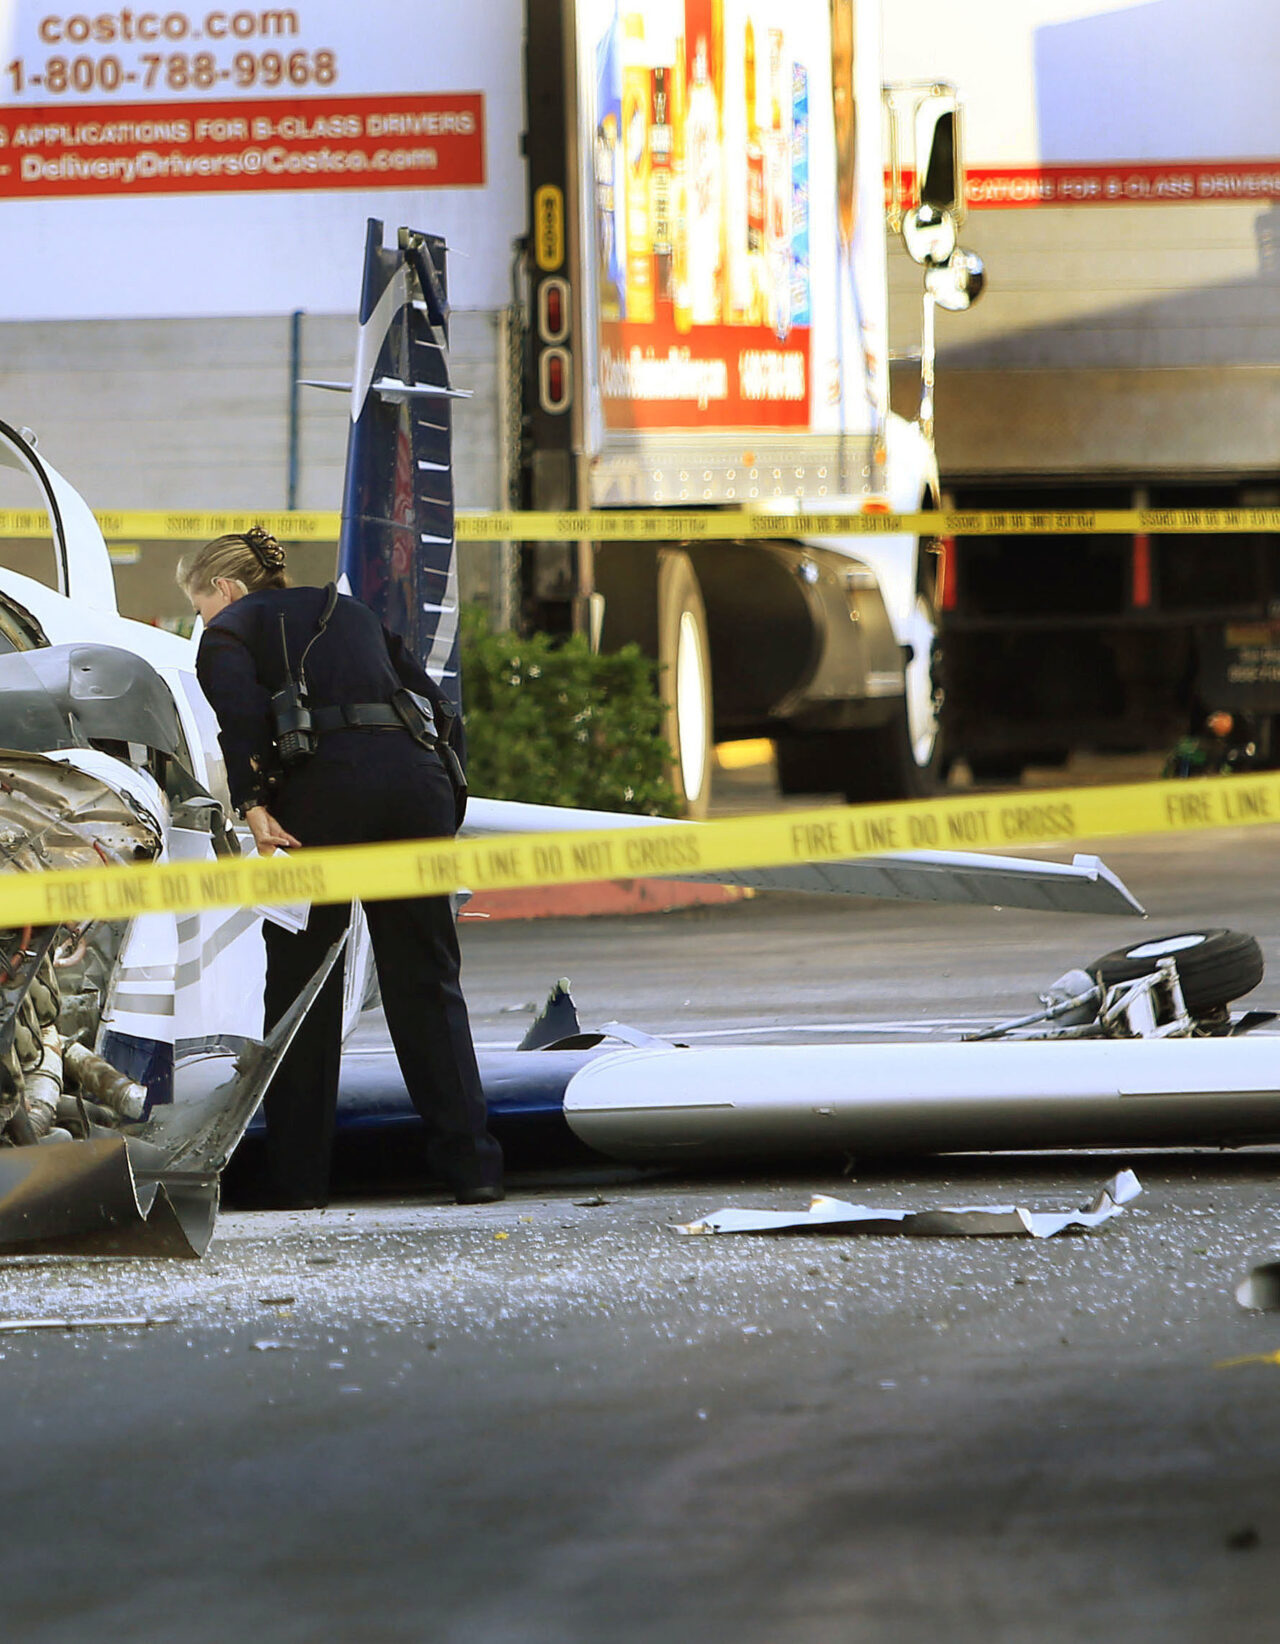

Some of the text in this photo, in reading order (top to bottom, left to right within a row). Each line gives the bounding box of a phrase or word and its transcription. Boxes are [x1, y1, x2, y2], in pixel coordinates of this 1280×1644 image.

[38, 6, 299, 44] costco.com
[5, 50, 337, 93] 1-800-788-9968
[11, 119, 190, 149] APPLICATIONS
[196, 118, 249, 142] FOR
[252, 115, 363, 140] B-CLASS
[367, 110, 476, 136] DRIVERS
[20, 147, 439, 184] DeliveryDrivers@Costco.com
[1058, 176, 1102, 200] FOR
[1165, 786, 1271, 825] FIRE LINE
[791, 803, 1076, 856] FIRE LINE DO NOT CROSS
[417, 833, 703, 888] FIRE LINE DO NOT CROSS
[45, 864, 327, 916] FIRE LINE DO NOT CROSS
